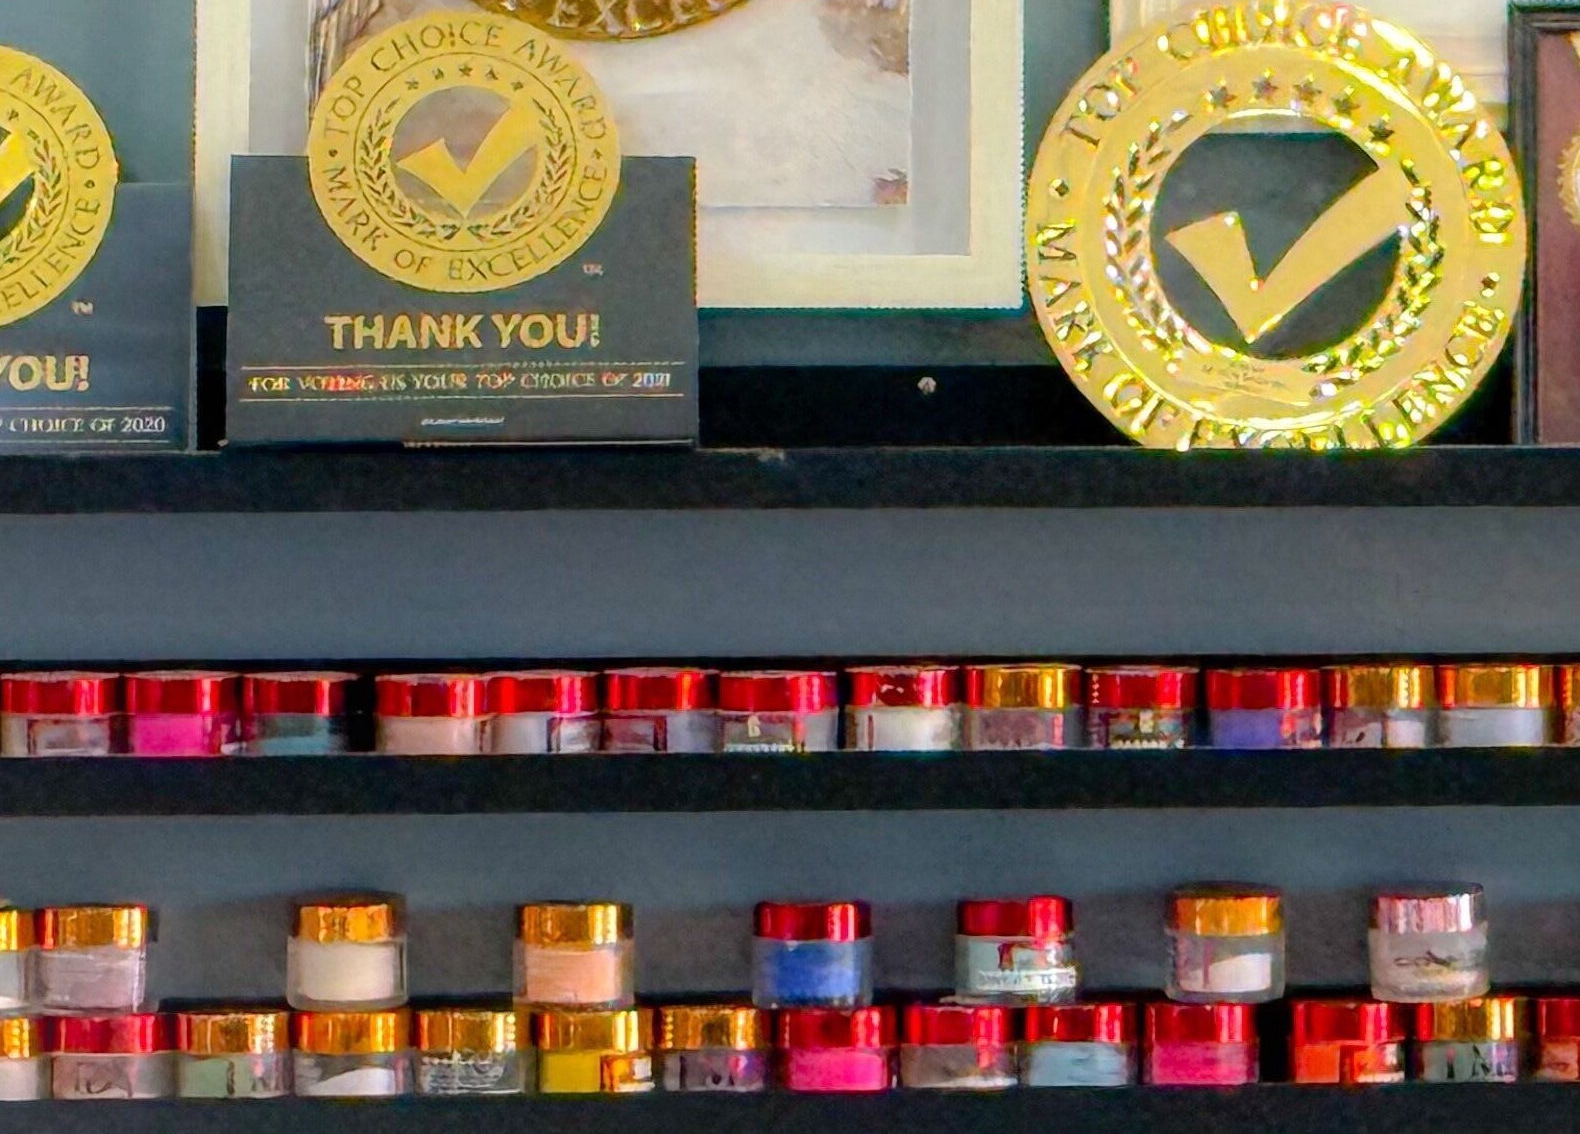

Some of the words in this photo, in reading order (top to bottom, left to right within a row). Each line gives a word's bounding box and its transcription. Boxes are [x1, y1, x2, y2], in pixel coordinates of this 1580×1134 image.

[9, 66, 102, 171] AWARD
[322, 76, 366, 139] TOP
[370, 20, 504, 72] CHOICE
[512, 38, 607, 141] AWARD
[1064, 56, 1142, 149] TOP
[0, 197, 102, 310] ELLENCE
[325, 166, 388, 253] MARK
[393, 248, 432, 274] OF
[447, 163, 607, 282] EXCELLENCE
[323, 313, 483, 351] THANK
[490, 312, 601, 350] YOU!
[1034, 219, 1115, 380] MARK
[120, 417, 167, 433] 2020
[520, 372, 597, 390] CHOICE
